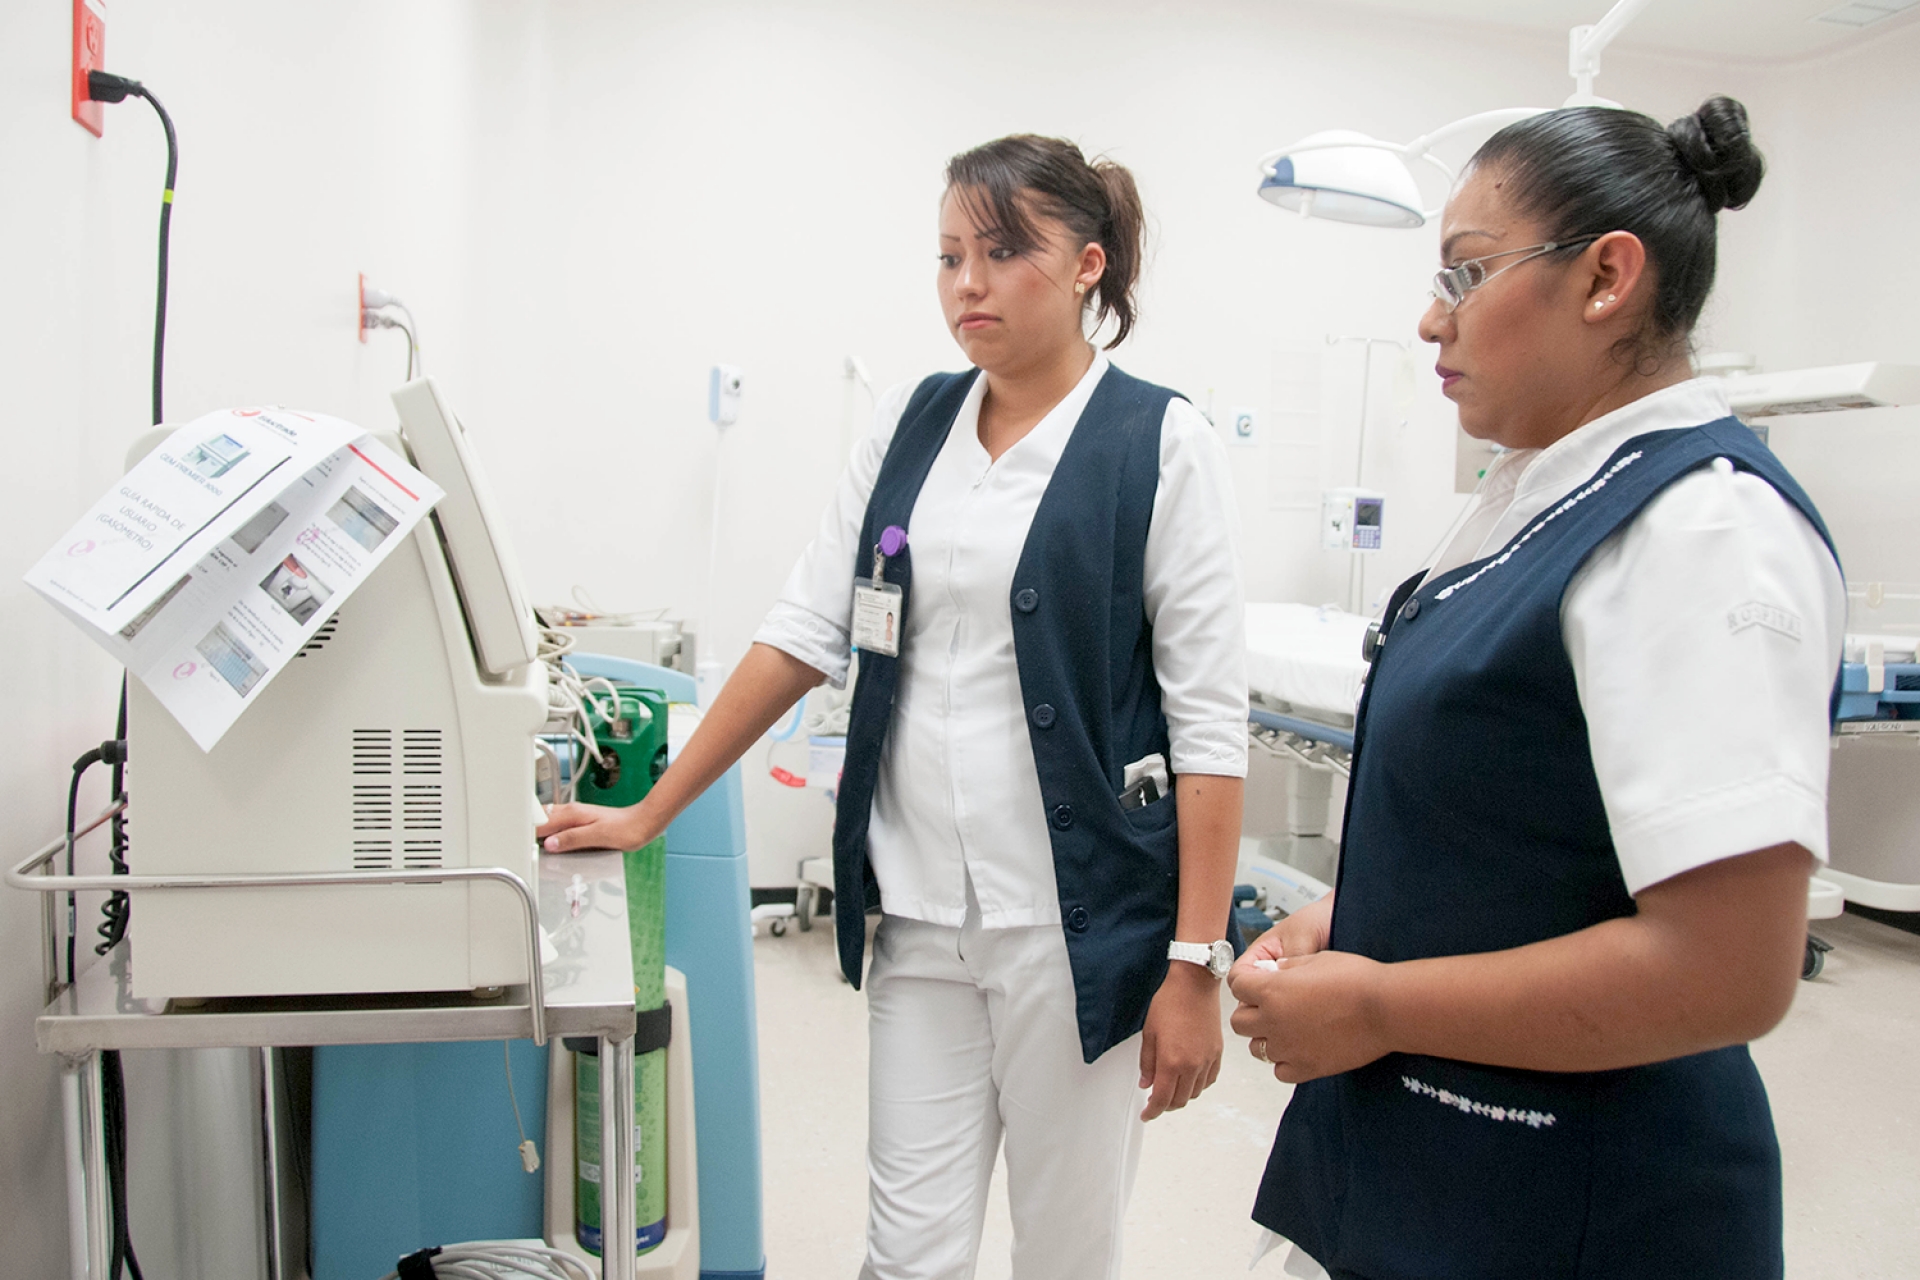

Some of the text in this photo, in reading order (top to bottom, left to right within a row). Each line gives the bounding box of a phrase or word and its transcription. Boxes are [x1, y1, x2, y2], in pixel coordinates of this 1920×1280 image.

[174, 461, 206, 485] PREMIER
[119, 505, 157, 532] USUARIO
[170, 518, 186, 532] DE
